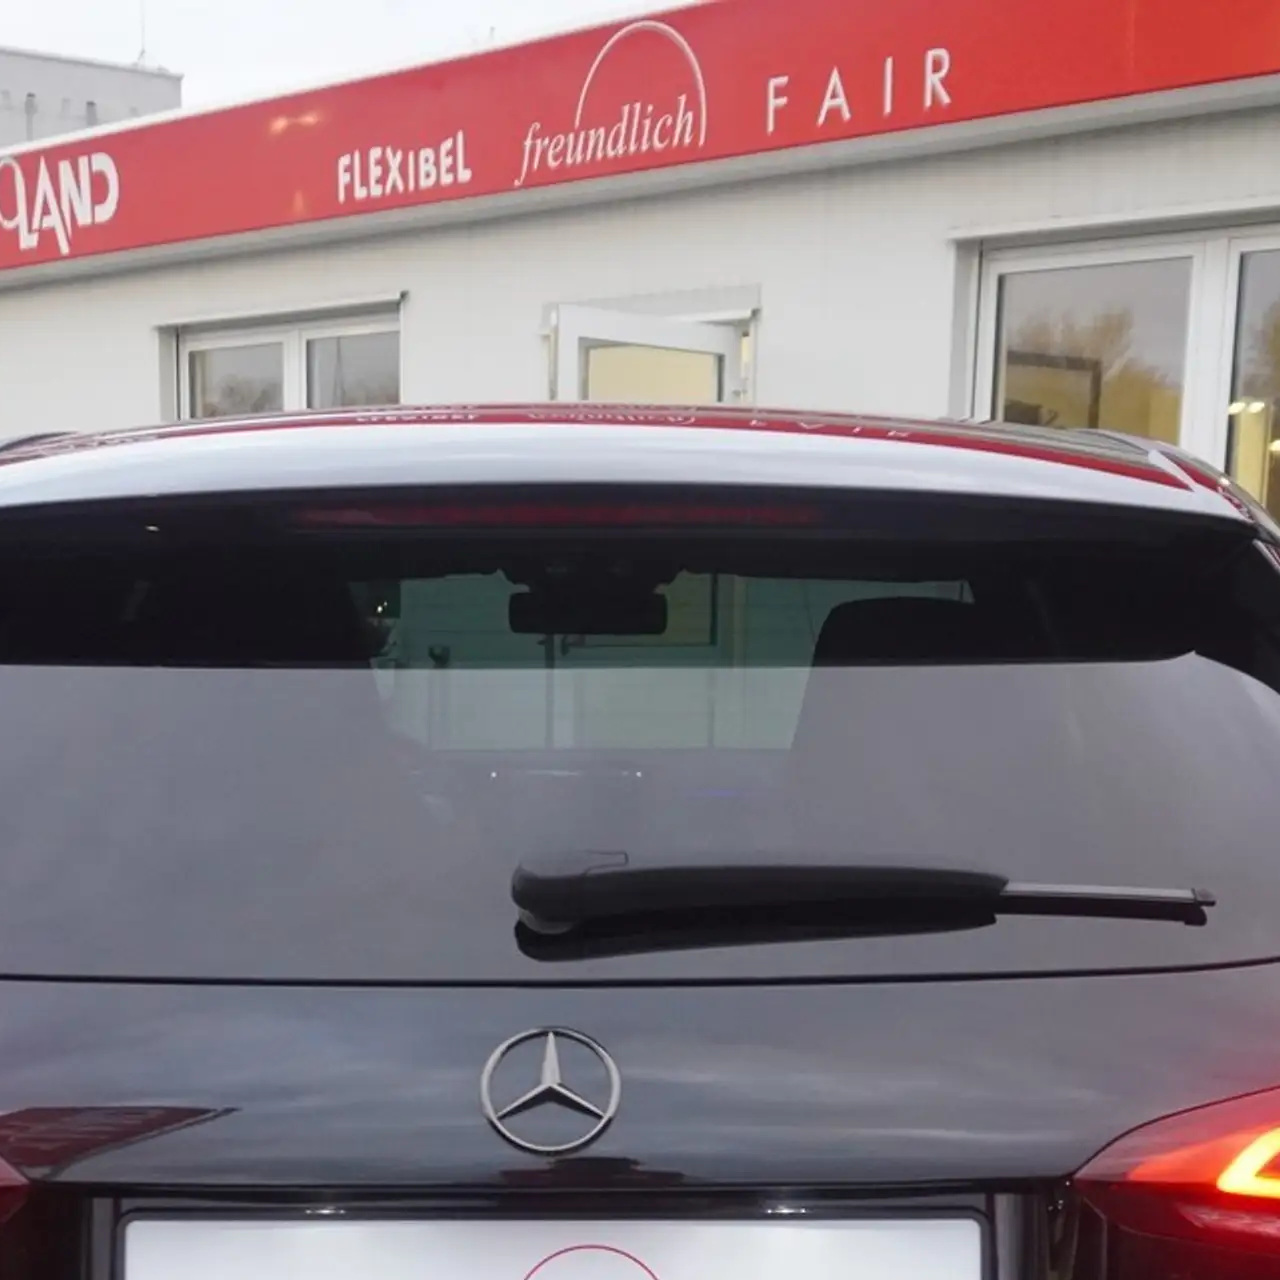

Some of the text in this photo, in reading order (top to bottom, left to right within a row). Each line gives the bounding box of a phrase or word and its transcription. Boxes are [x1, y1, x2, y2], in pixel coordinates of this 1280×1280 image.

[336, 47, 952, 204] FLEXIBEL freundlich FAIR
